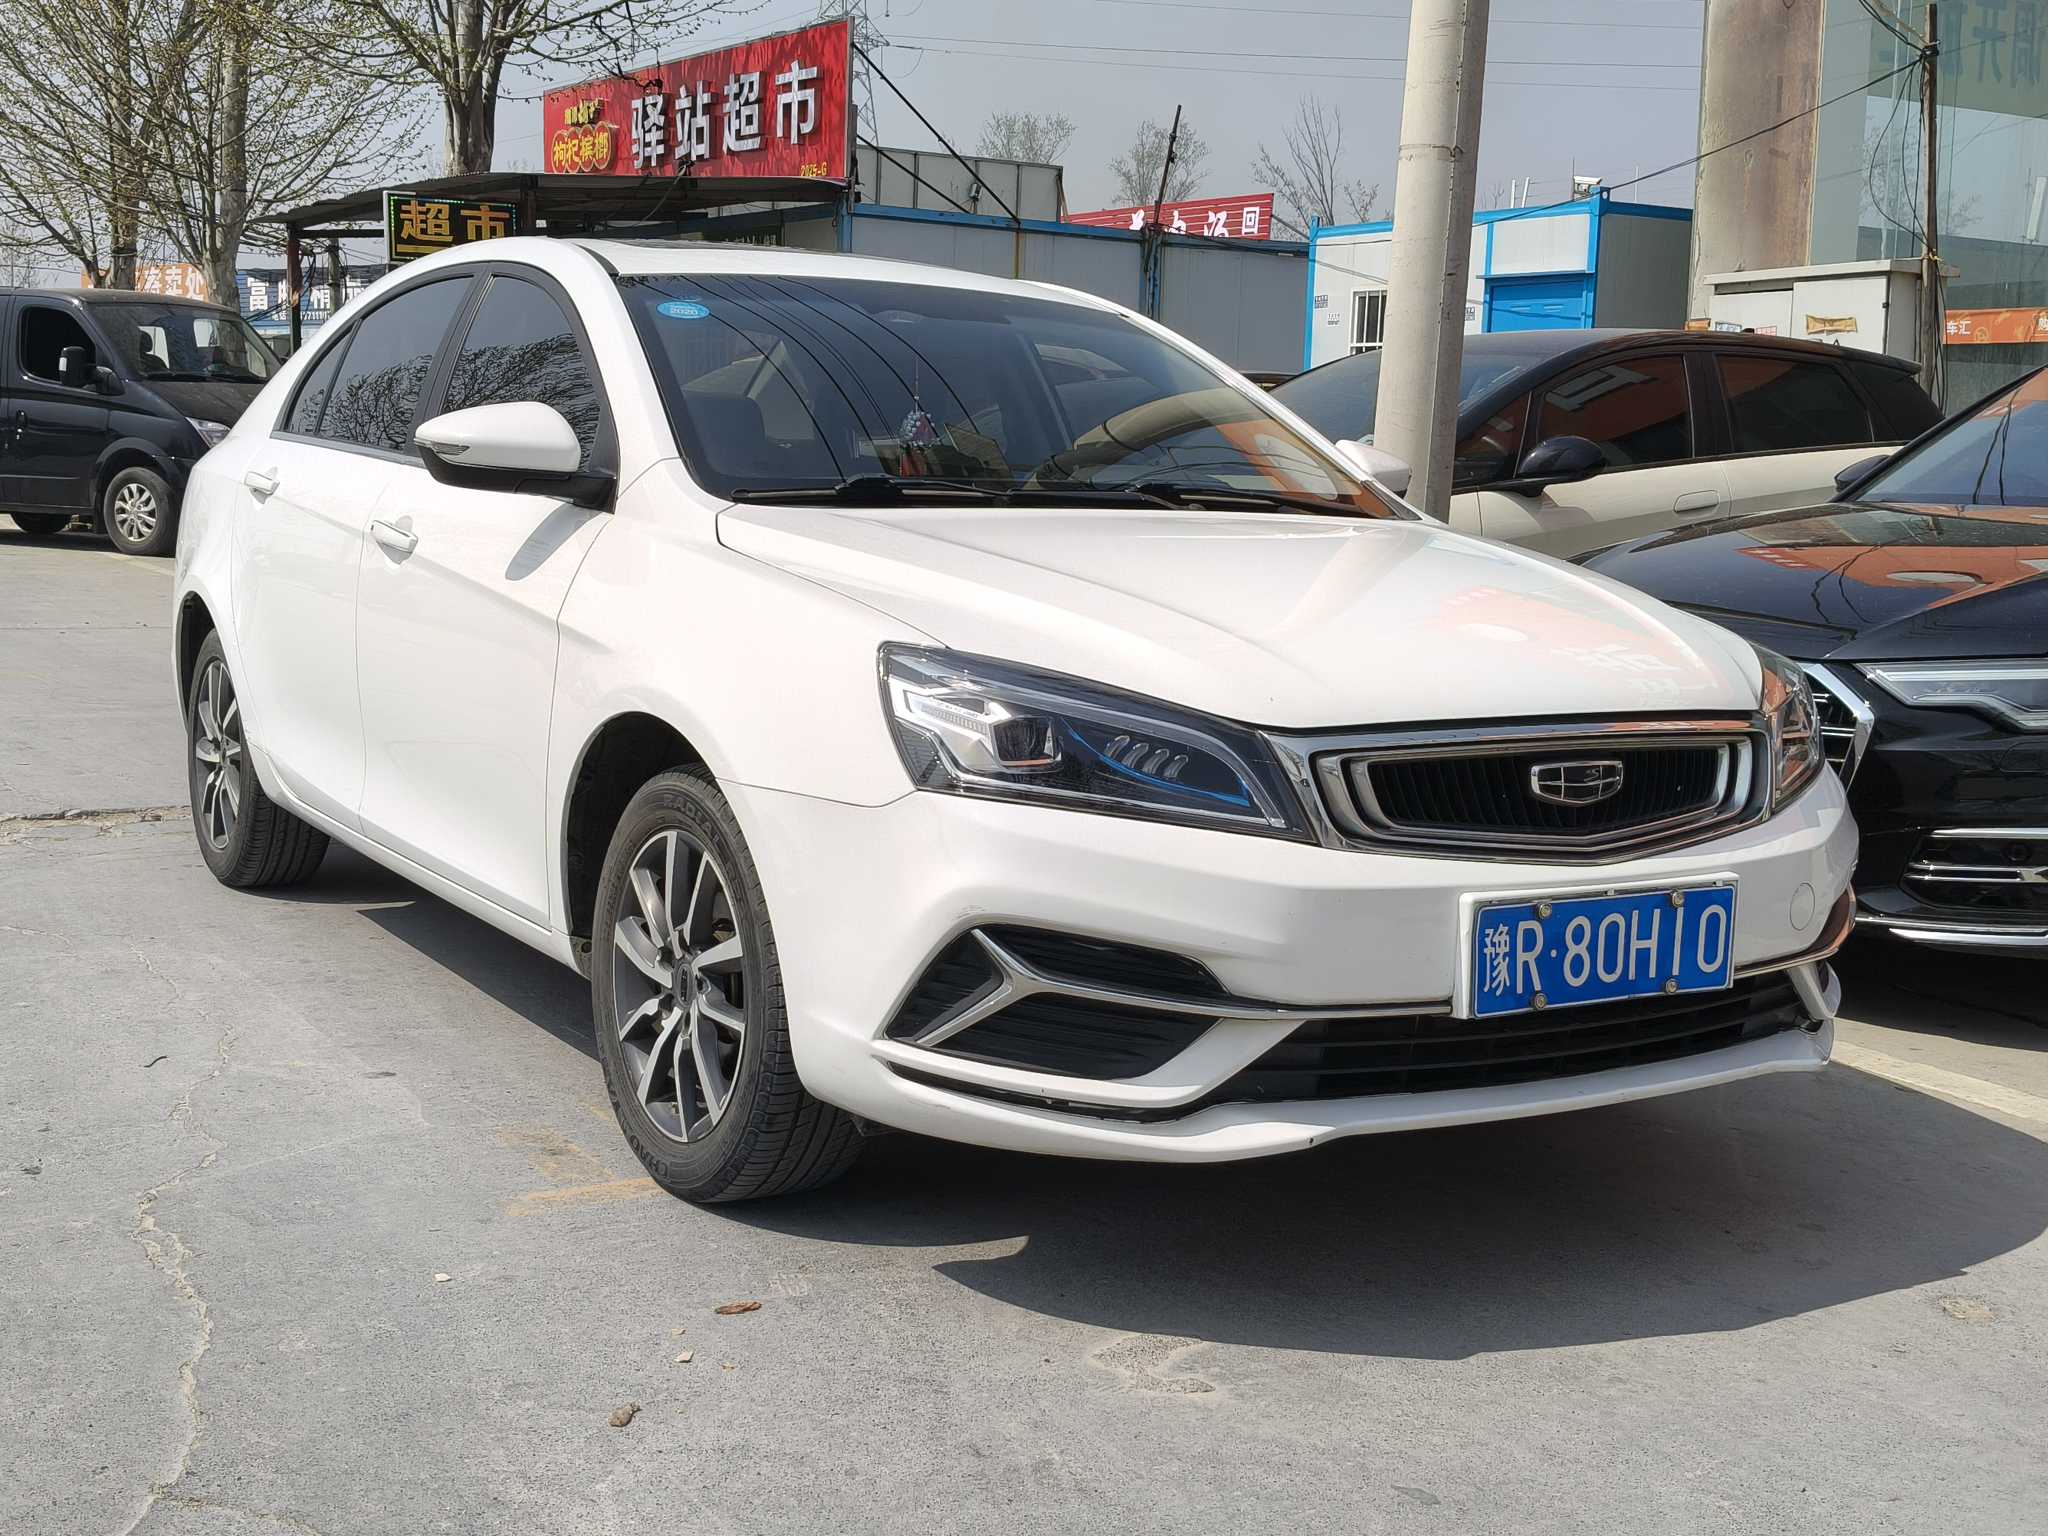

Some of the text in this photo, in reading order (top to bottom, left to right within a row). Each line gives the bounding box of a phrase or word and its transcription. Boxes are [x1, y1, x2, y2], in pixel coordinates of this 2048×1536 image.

[631, 60, 817, 169] 驿站超市
[400, 199, 510, 241] 超市
